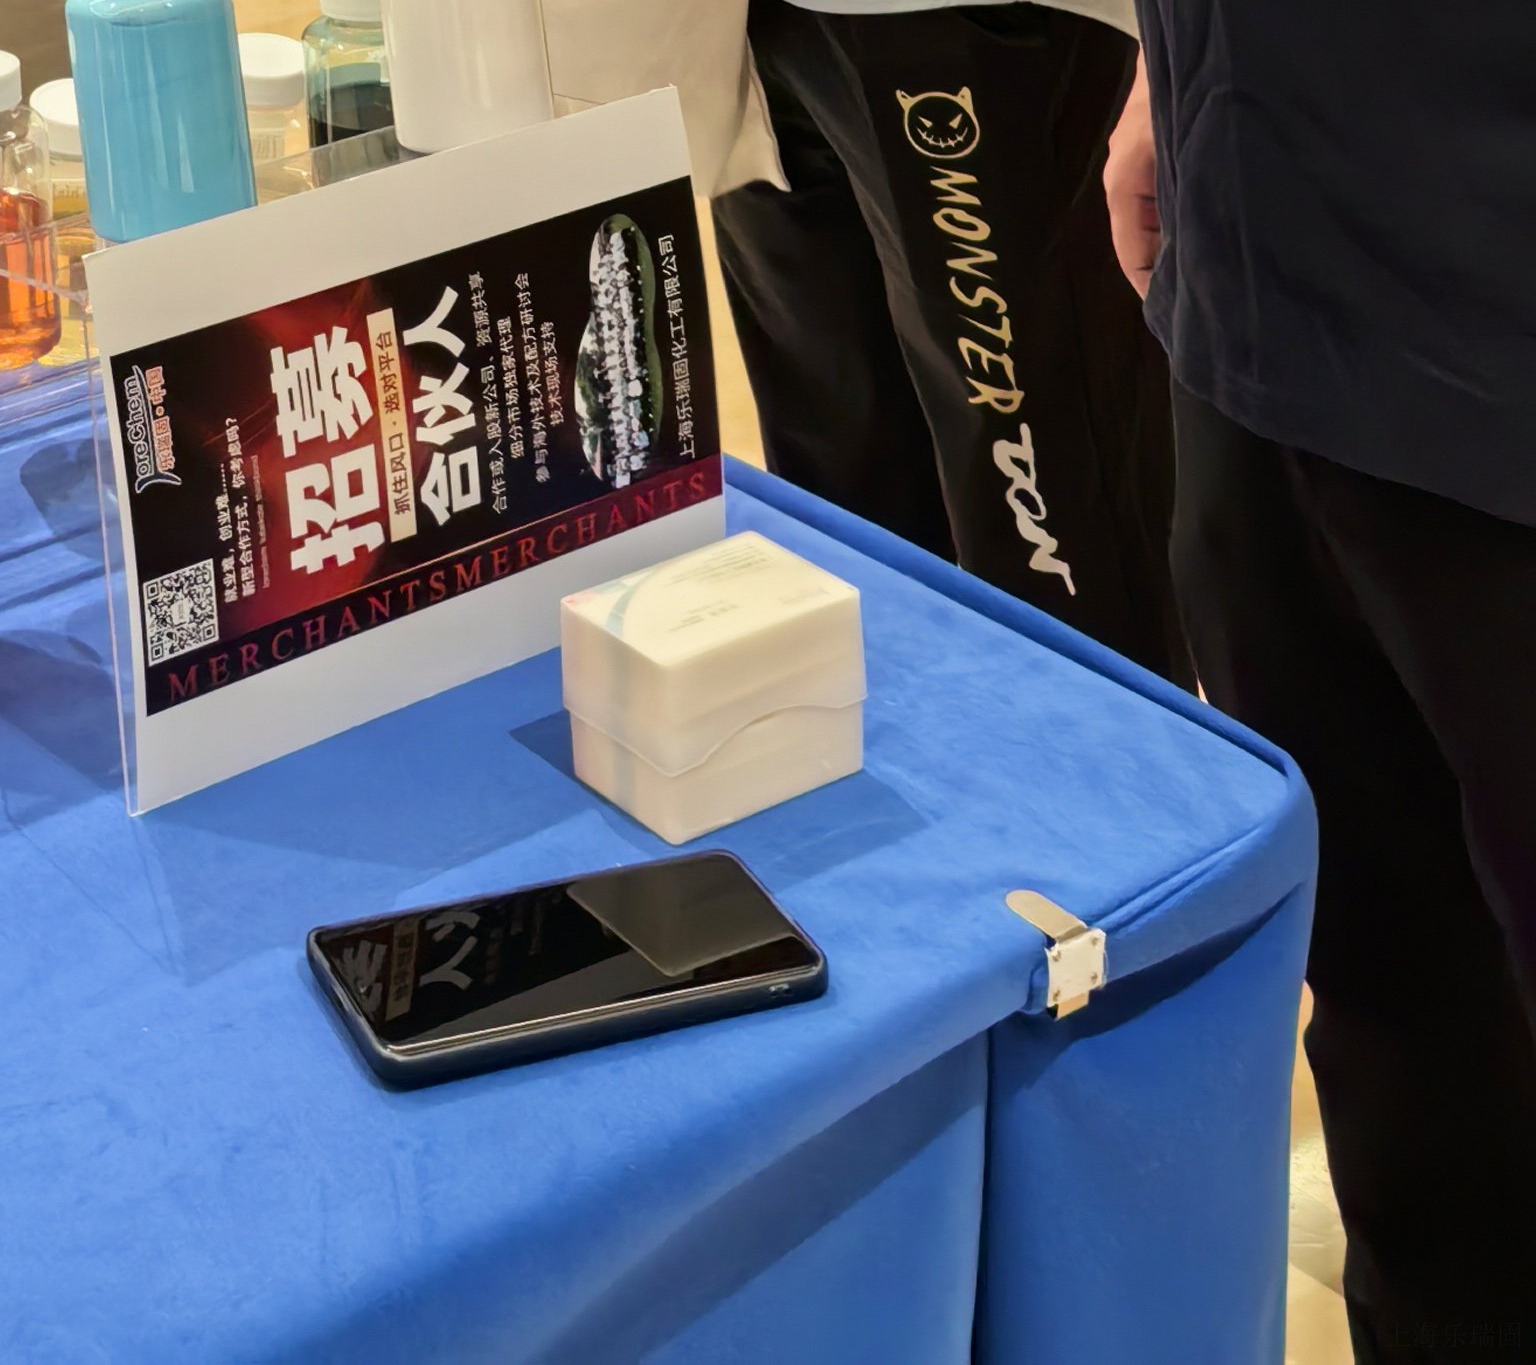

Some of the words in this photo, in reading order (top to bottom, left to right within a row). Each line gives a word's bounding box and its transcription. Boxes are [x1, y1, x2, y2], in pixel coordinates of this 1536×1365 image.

[402, 285, 482, 526] 合伙人
[658, 234, 696, 459] 上海乐瑞固化工有限公司
[930, 165, 1024, 414] MONSTER
[270, 325, 385, 574] 招募
